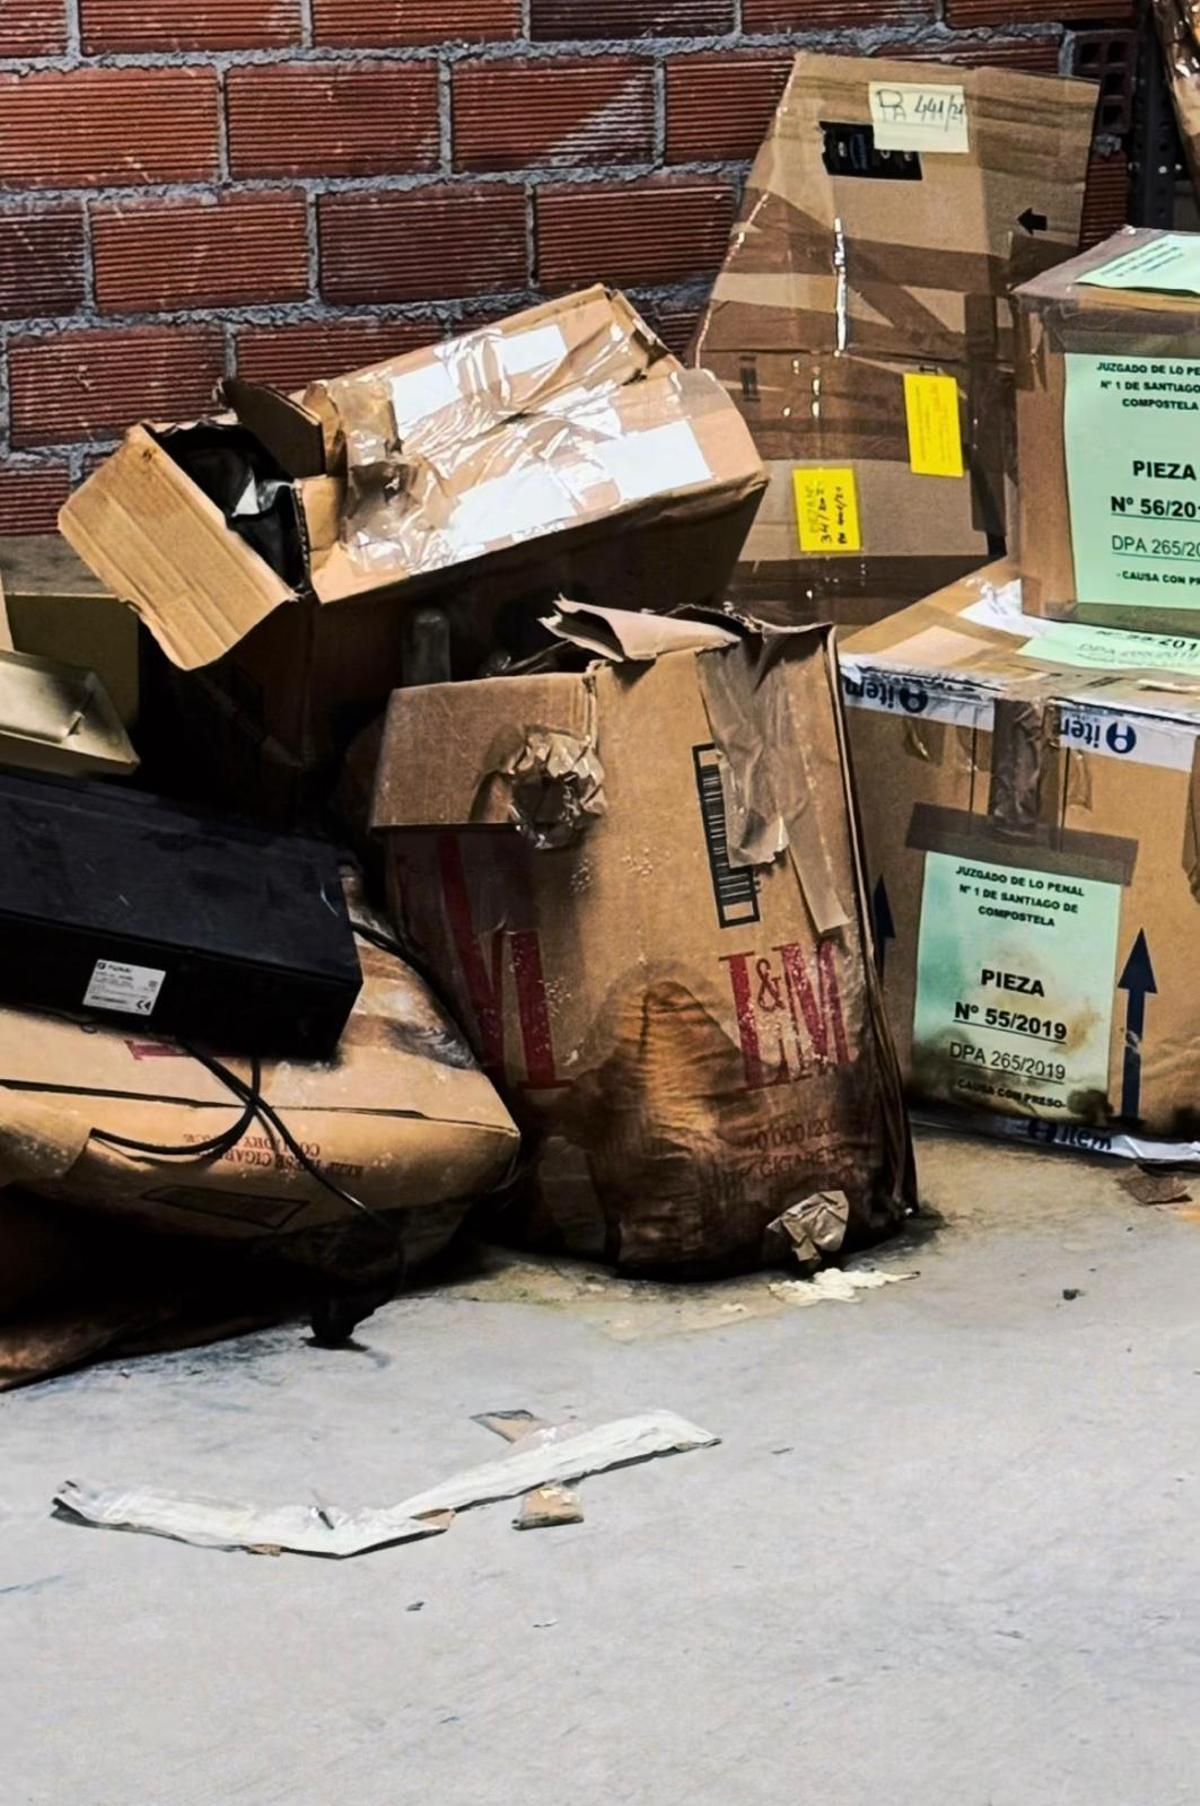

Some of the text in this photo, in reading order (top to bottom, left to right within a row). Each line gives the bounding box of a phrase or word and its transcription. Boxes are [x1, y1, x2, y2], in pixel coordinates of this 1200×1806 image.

[1096, 362, 1148, 374] JUZGADO
[1151, 364, 1166, 375] DE
[1169, 365, 1184, 376] LO
[1125, 381, 1140, 390] DE
[1122, 398, 1199, 410] COMPOSTELA
[1133, 460, 1197, 481] PIEZA
[1111, 496, 1200, 518] Nº 56/20
[1112, 535, 1148, 553] DPA
[1162, 574, 1186, 584] CON
[956, 866, 1084, 897] JUZGADO DE LO PENAL
[983, 889, 998, 900] DE
[1000, 892, 1060, 910] SANTIAGO
[1063, 903, 1078, 914] DE
[978, 905, 1055, 927] COMPOSTELA
[981, 969, 1045, 998] PIEZA
[955, 1002, 1067, 1040] Nº 55/2019
[950, 1042, 1066, 1080] DPA 265/2019
